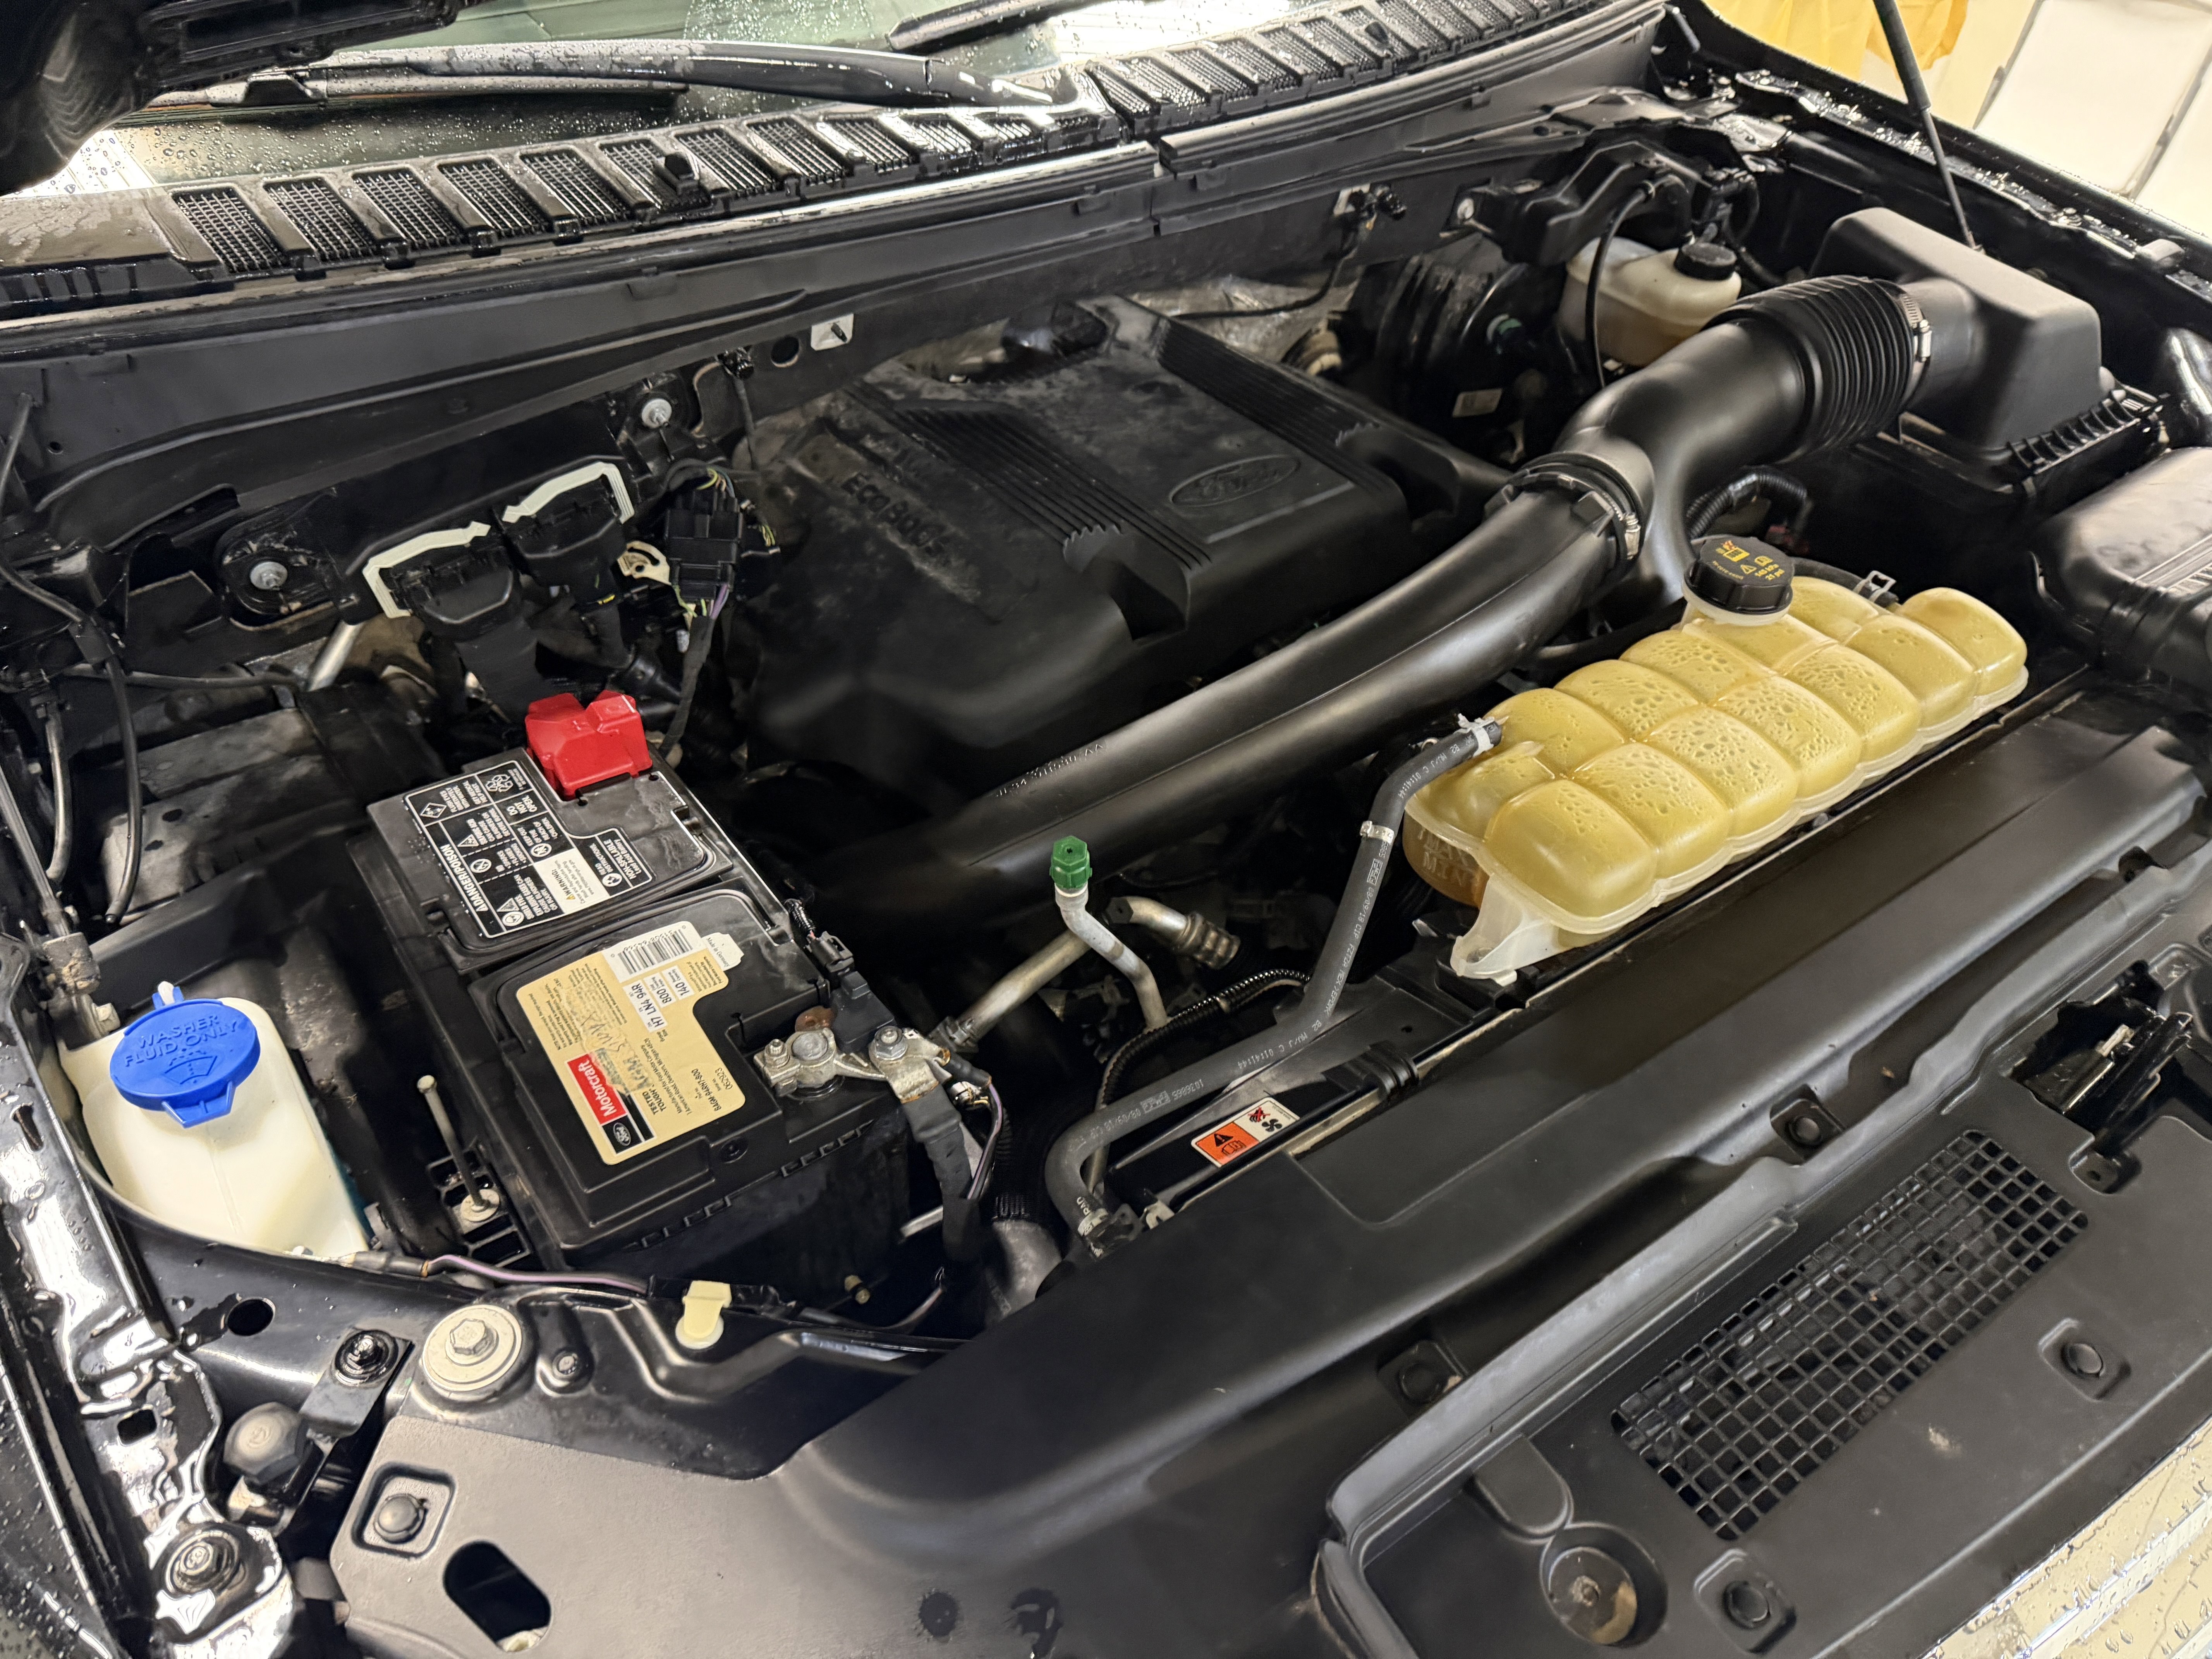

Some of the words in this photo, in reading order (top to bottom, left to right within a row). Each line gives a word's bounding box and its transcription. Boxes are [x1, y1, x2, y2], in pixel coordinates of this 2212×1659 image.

[841, 472, 956, 568] ECOBOOS
[461, 780, 477, 797] MEDICAL
[1398, 772, 1421, 799] 01:41:44
[439, 790, 450, 801] EYES
[445, 787, 464, 811] IMMEDIATELY
[460, 797, 471, 808] WITH
[471, 795, 482, 805] GET
[477, 792, 488, 803] HELP
[520, 795, 538, 812] OPEN.
[445, 799, 458, 813] FLUSH
[505, 805, 517, 816] DO
[514, 800, 528, 814] NOT
[466, 818, 478, 828] ACID
[477, 820, 491, 834] CAUSE
[485, 817, 503, 840] BLINDNESS
[496, 821, 511, 837] SEVERE
[517, 826, 528, 836] OUT
[471, 826, 488, 845] SULFURIC
[485, 832, 496, 842] CAN
[522, 835, 534, 846] KEEP
[528, 829, 539, 838] THE
[537, 826, 550, 840] REACH
[613, 838, 629, 854] Battery
[603, 839, 637, 879] NON-SPILLABLE
[623, 853, 635, 864] Acid
[440, 843, 485, 906] DANGER/POISON
[594, 862, 607, 875] READ
[629, 862, 642, 874] Lead
[512, 874, 524, 884] CAN
[549, 869, 572, 896] WARNING:
[518, 883, 532, 896] GASES
[523, 876, 543, 900] BLINDNESS
[520, 905, 535, 920] SHIELD
[525, 894, 544, 916] EXPLOSIVE
[537, 898, 552, 914] CAUSE
[549, 902, 558, 911] OR
[1358, 887, 1374, 923] 08/09/18
[630, 983, 647, 999] 94R
[656, 988, 672, 1004] 800
[675, 981, 690, 996] 140
[641, 998, 657, 1015] LN4
[650, 1015, 664, 1027] H7
[140, 1015, 220, 1049] WASHER
[125, 1043, 178, 1067] FLUID
[186, 1021, 237, 1046] ONLY
[640, 1044, 654, 1061] Company
[651, 1048, 665, 1066] Michigan
[1238, 1048, 1274, 1069] 01:41:44
[649, 1061, 659, 1072] Motor
[655, 1071, 664, 1081] Ford
[576, 1059, 617, 1117] Motorcraft
[641, 1091, 659, 1115] TESTED
[663, 1085, 683, 1113] Manufactured
[677, 1094, 691, 1112] American
